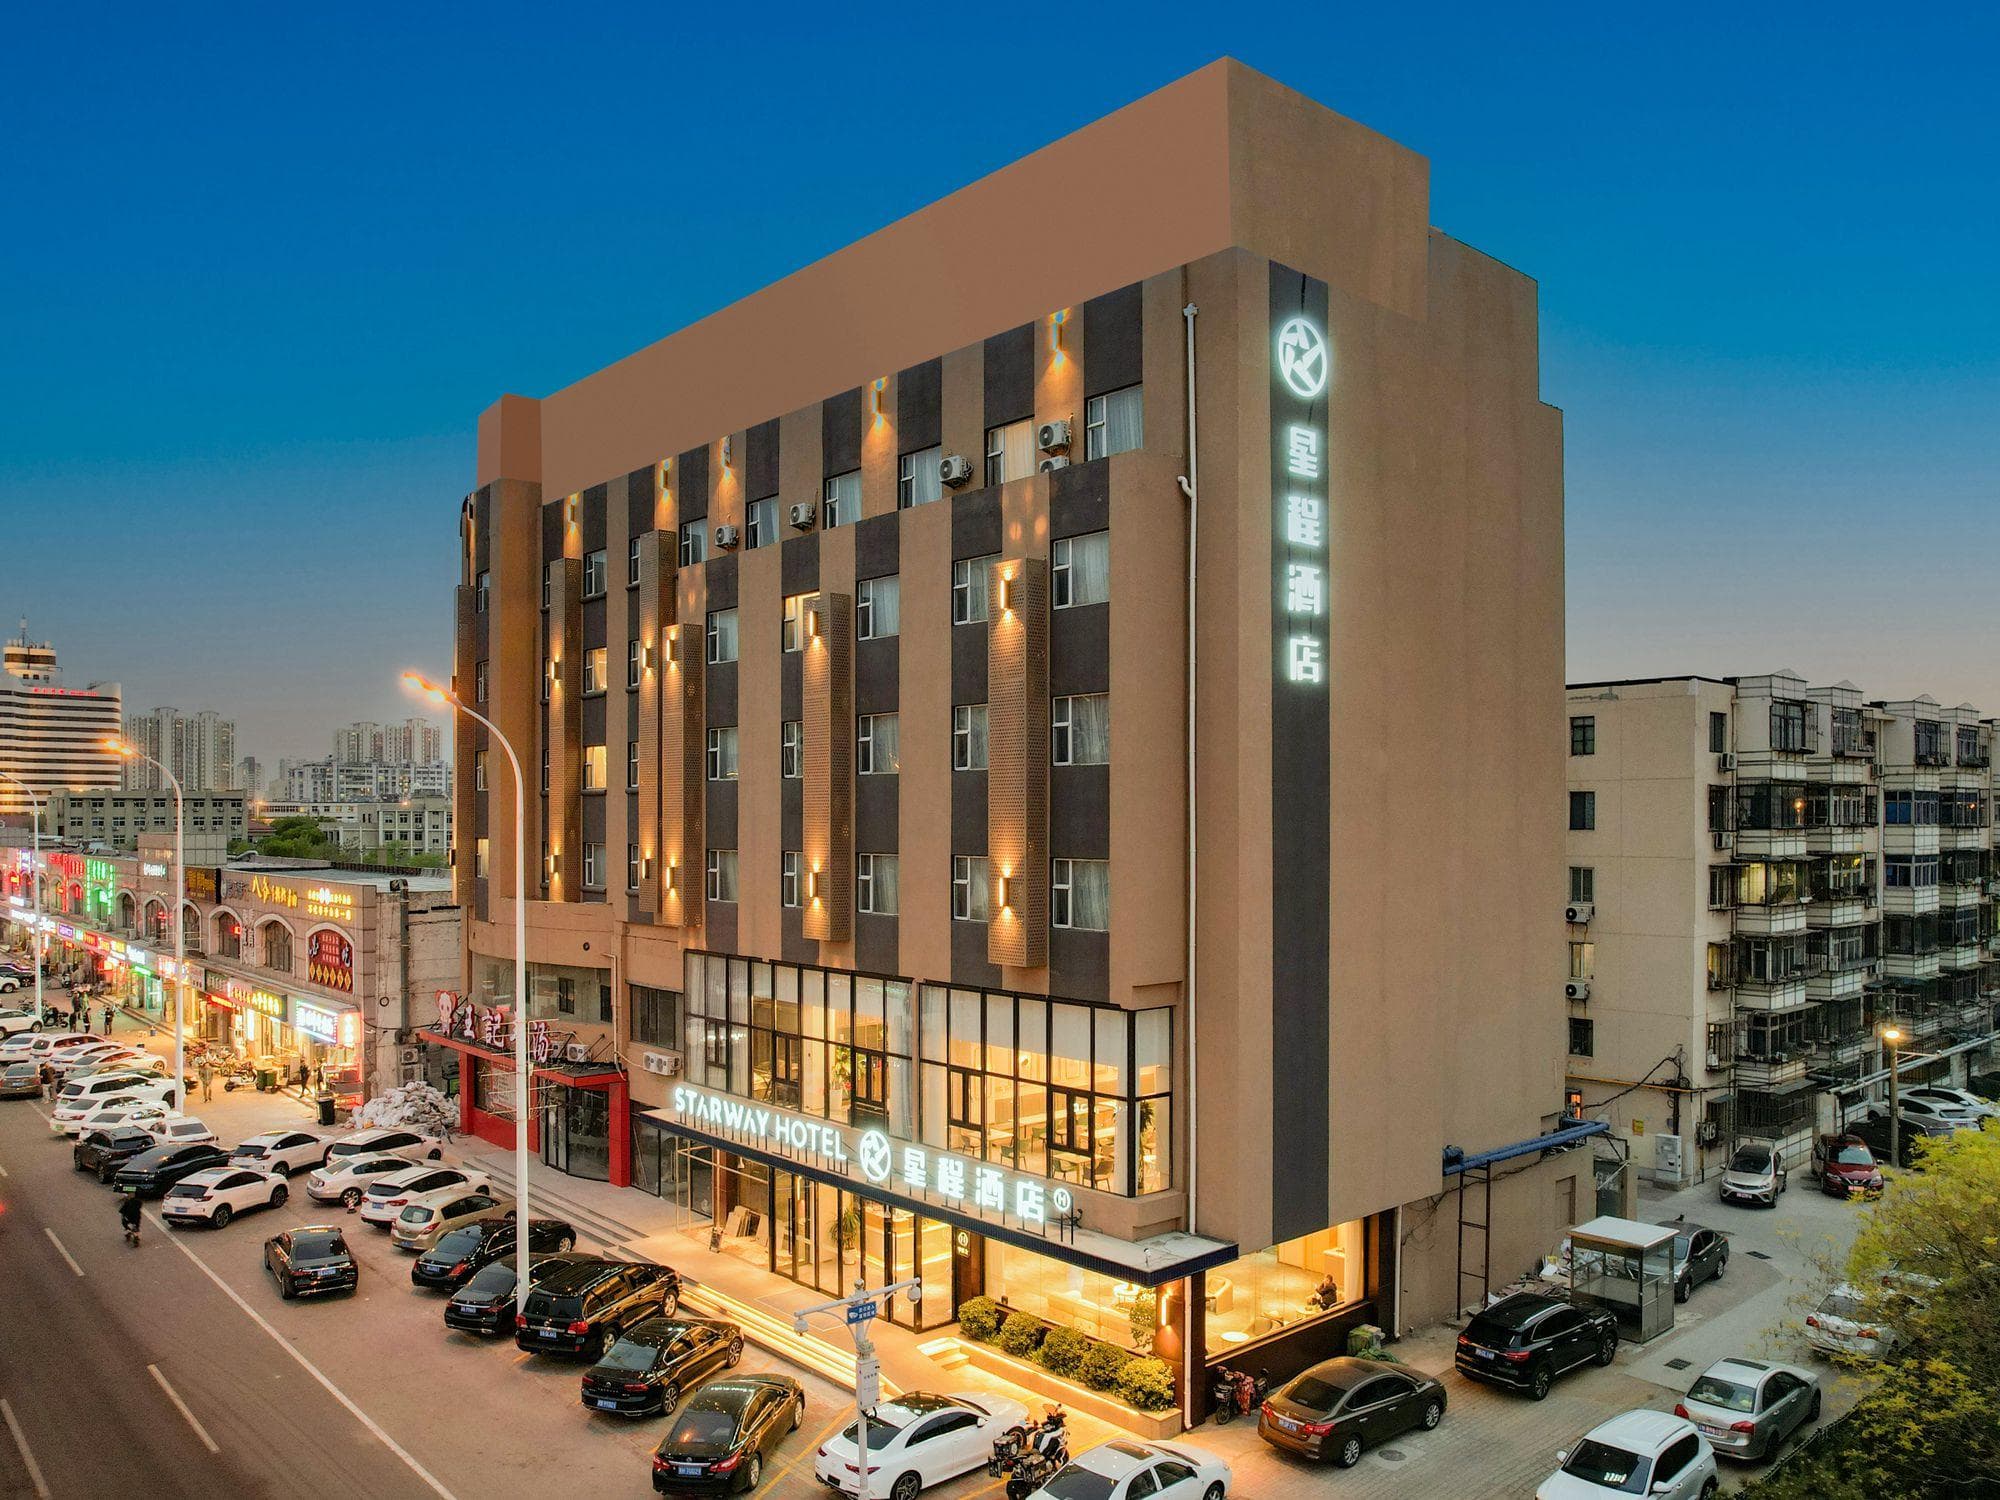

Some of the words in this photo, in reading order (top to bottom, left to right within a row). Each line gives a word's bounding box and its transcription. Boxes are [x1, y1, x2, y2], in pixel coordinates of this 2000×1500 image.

[1288, 426, 1320, 683] 星程酒店
[674, 1087, 770, 1137] STARWAY
[775, 1115, 848, 1161] HOTEL
[904, 1147, 1044, 1223] 星程酒店
